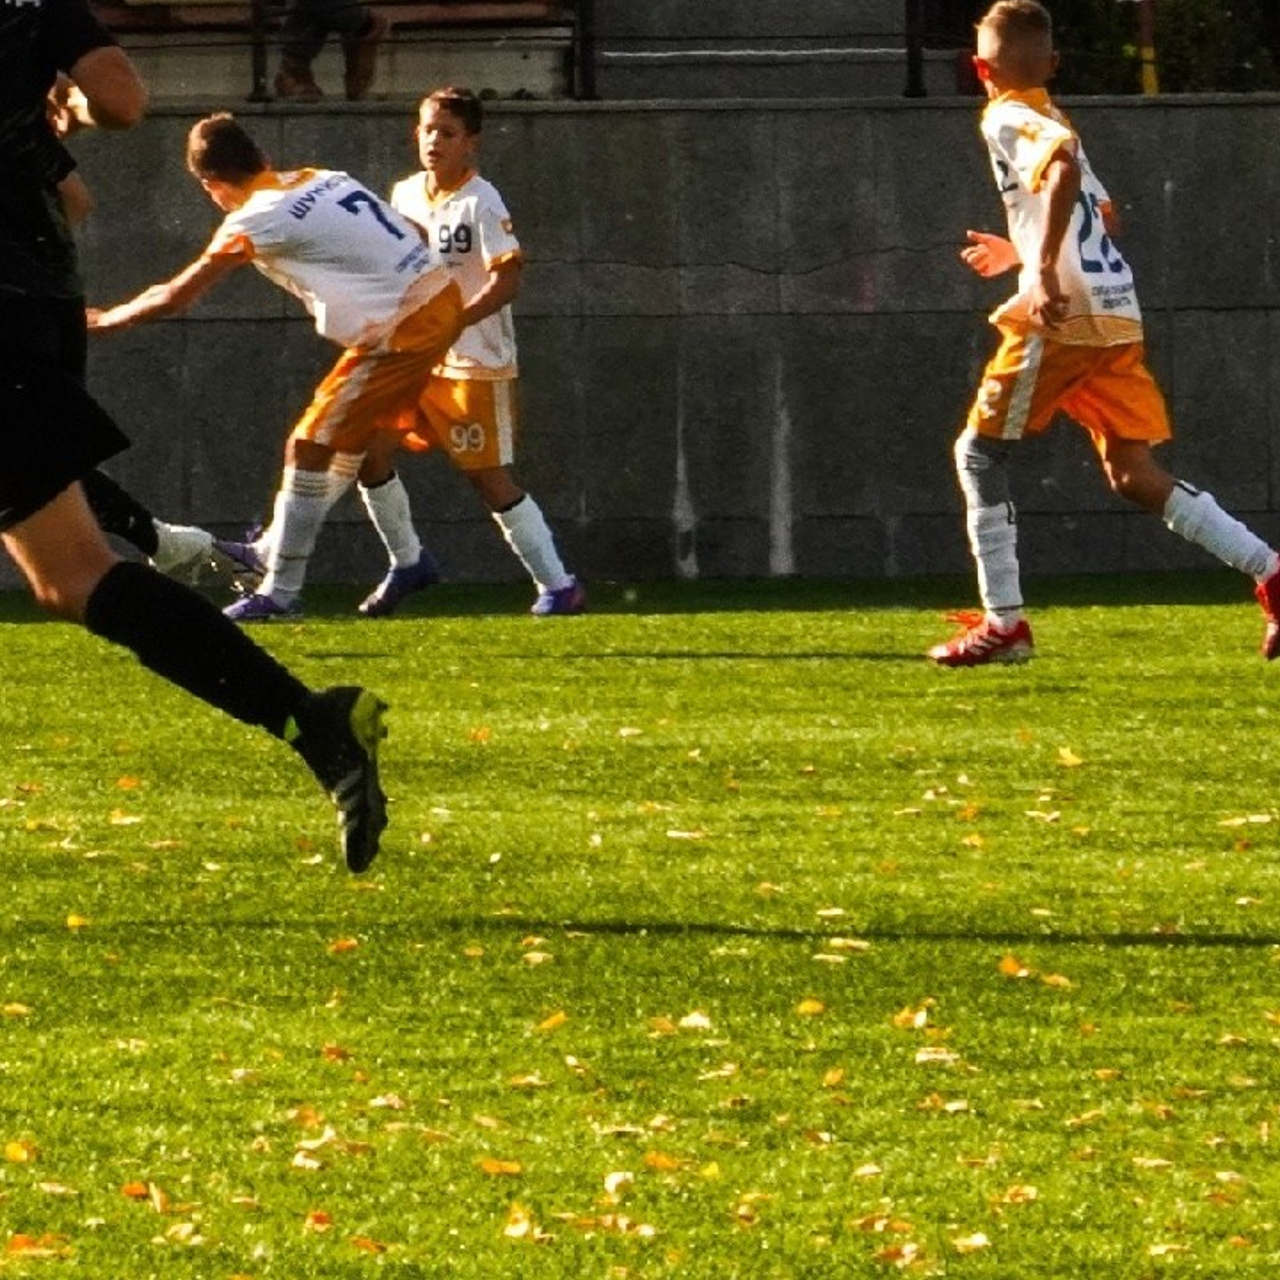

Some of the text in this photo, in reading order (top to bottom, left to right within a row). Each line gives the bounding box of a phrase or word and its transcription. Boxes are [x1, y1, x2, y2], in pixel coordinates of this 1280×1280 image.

[336, 189, 405, 241] 7
[438, 223, 472, 254] 99
[451, 423, 485, 454] 99
